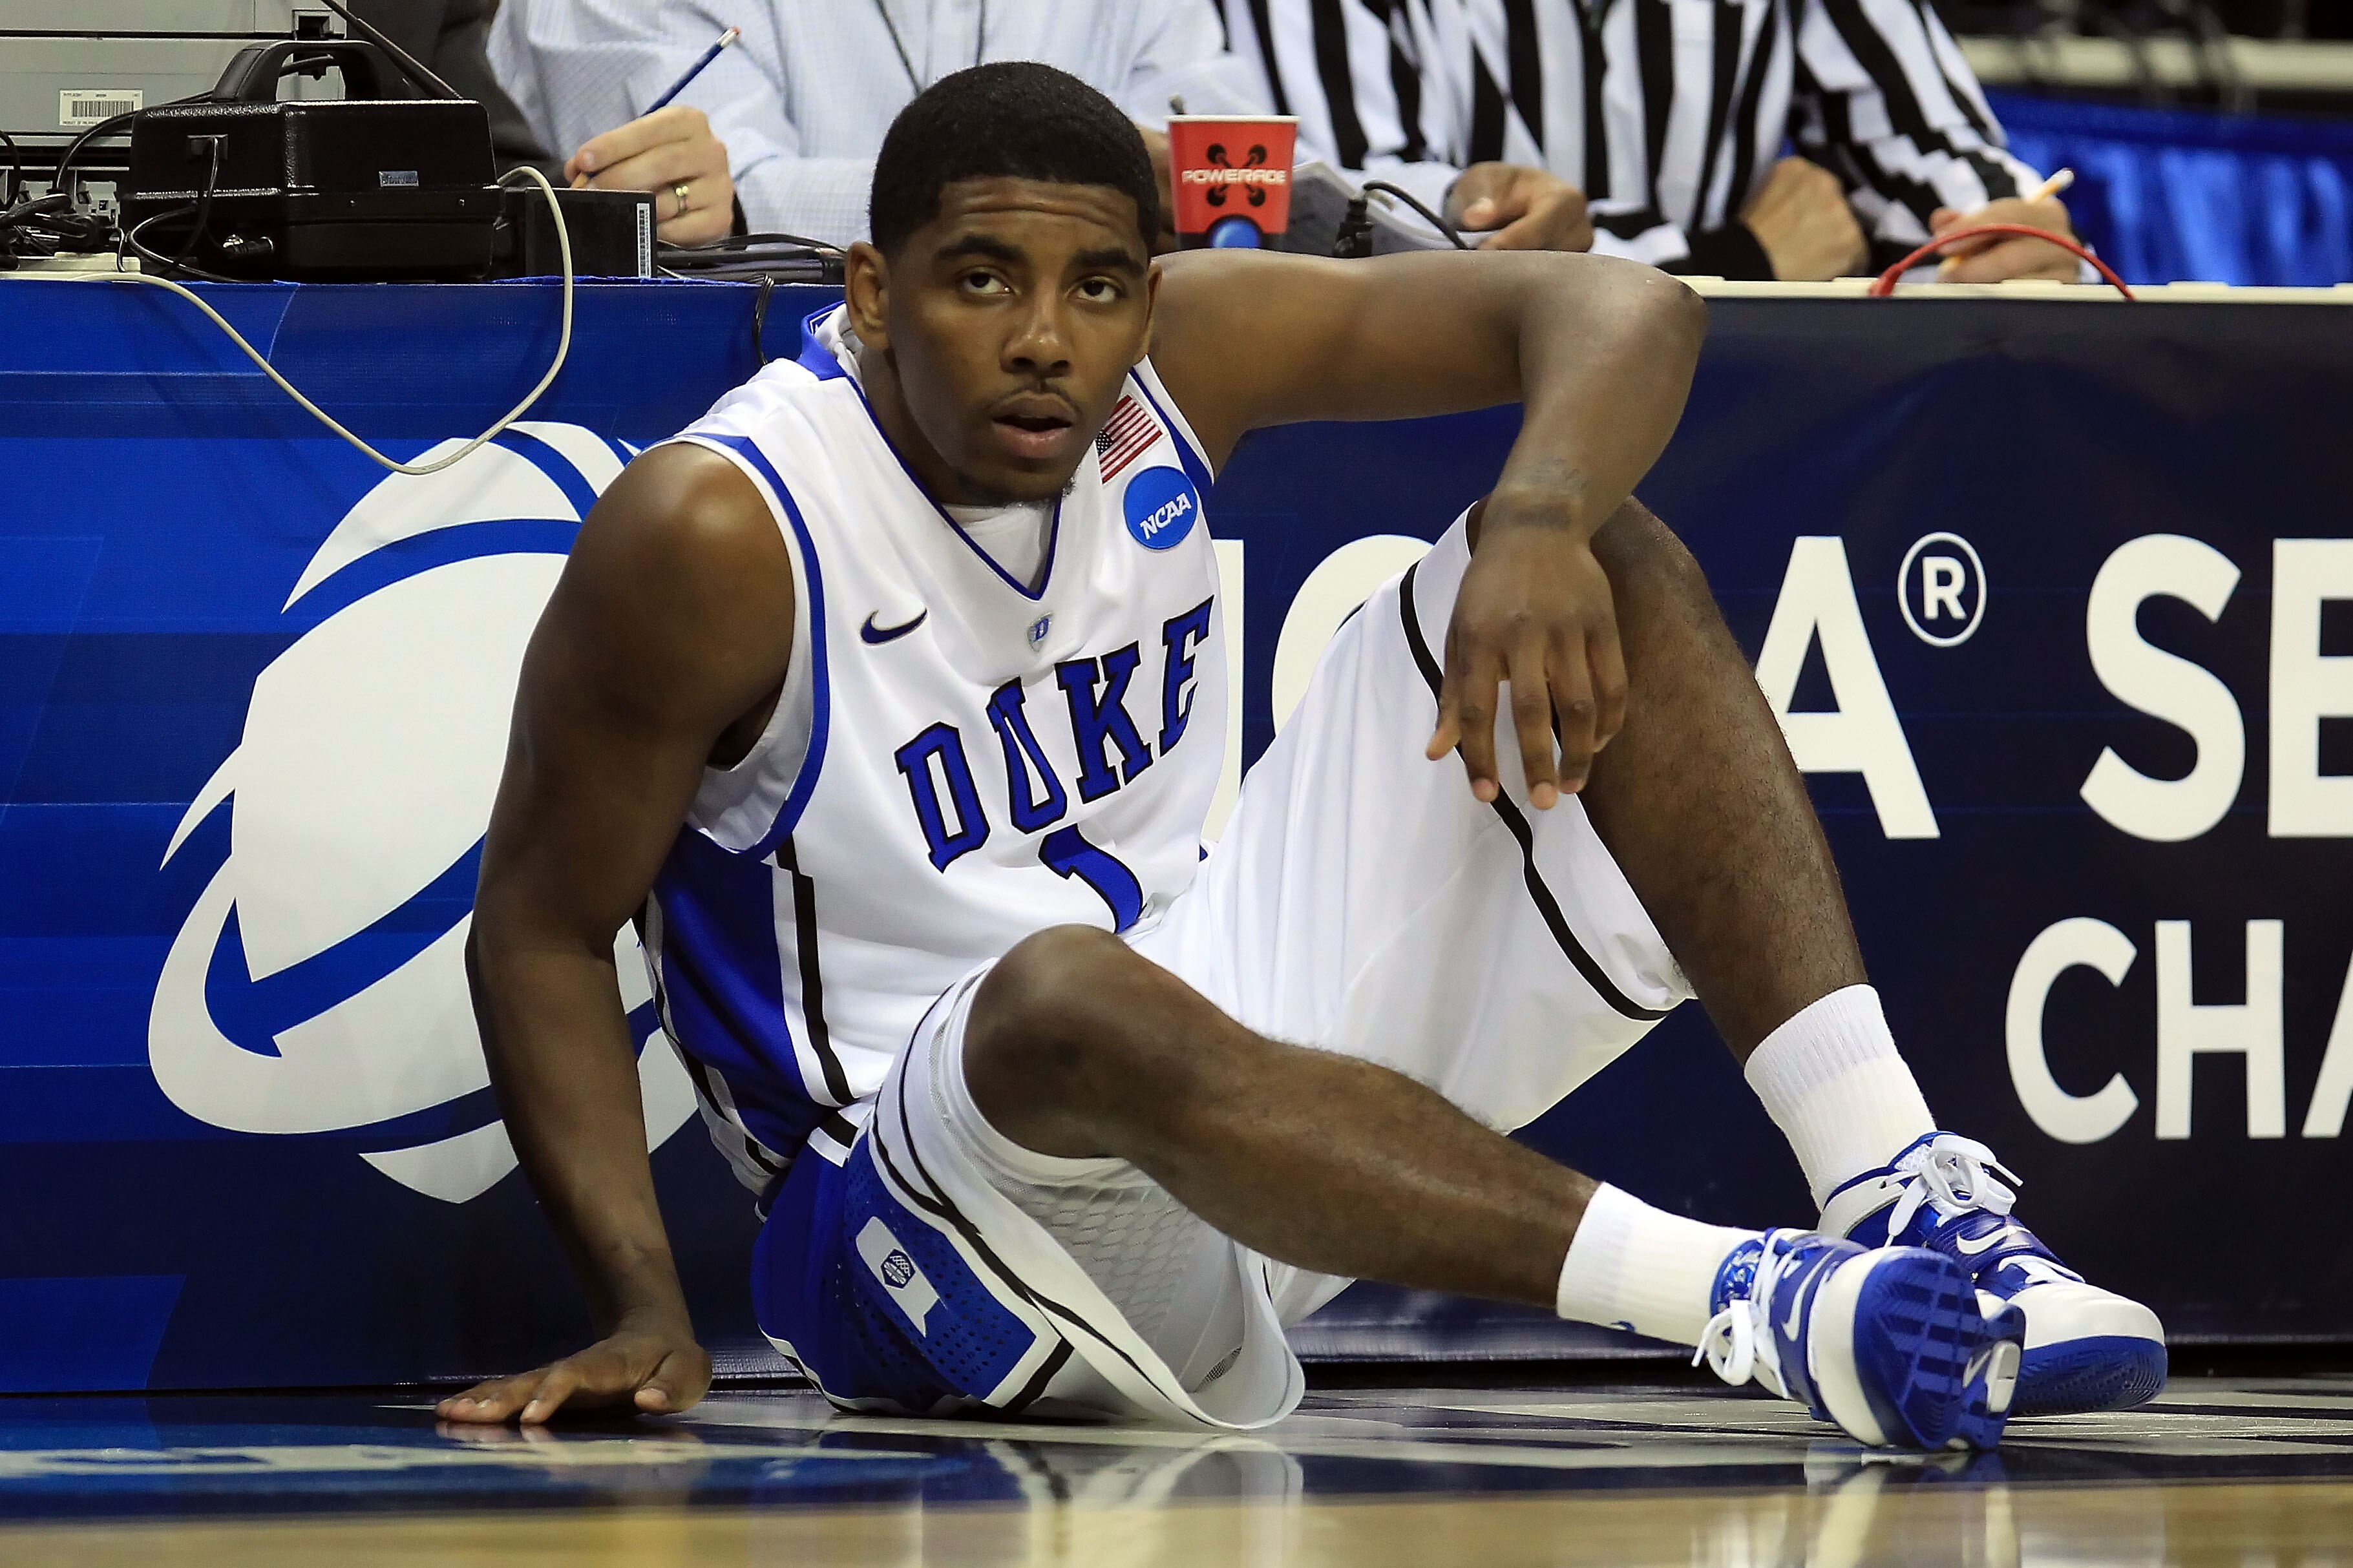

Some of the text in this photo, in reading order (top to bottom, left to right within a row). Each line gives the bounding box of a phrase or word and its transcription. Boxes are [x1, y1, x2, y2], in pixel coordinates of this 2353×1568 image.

[1181, 169, 1287, 185] POWERADE
[1139, 492, 1192, 539] NCAA
[894, 594, 1214, 874] DUKE
[1037, 822, 1147, 934] 1
